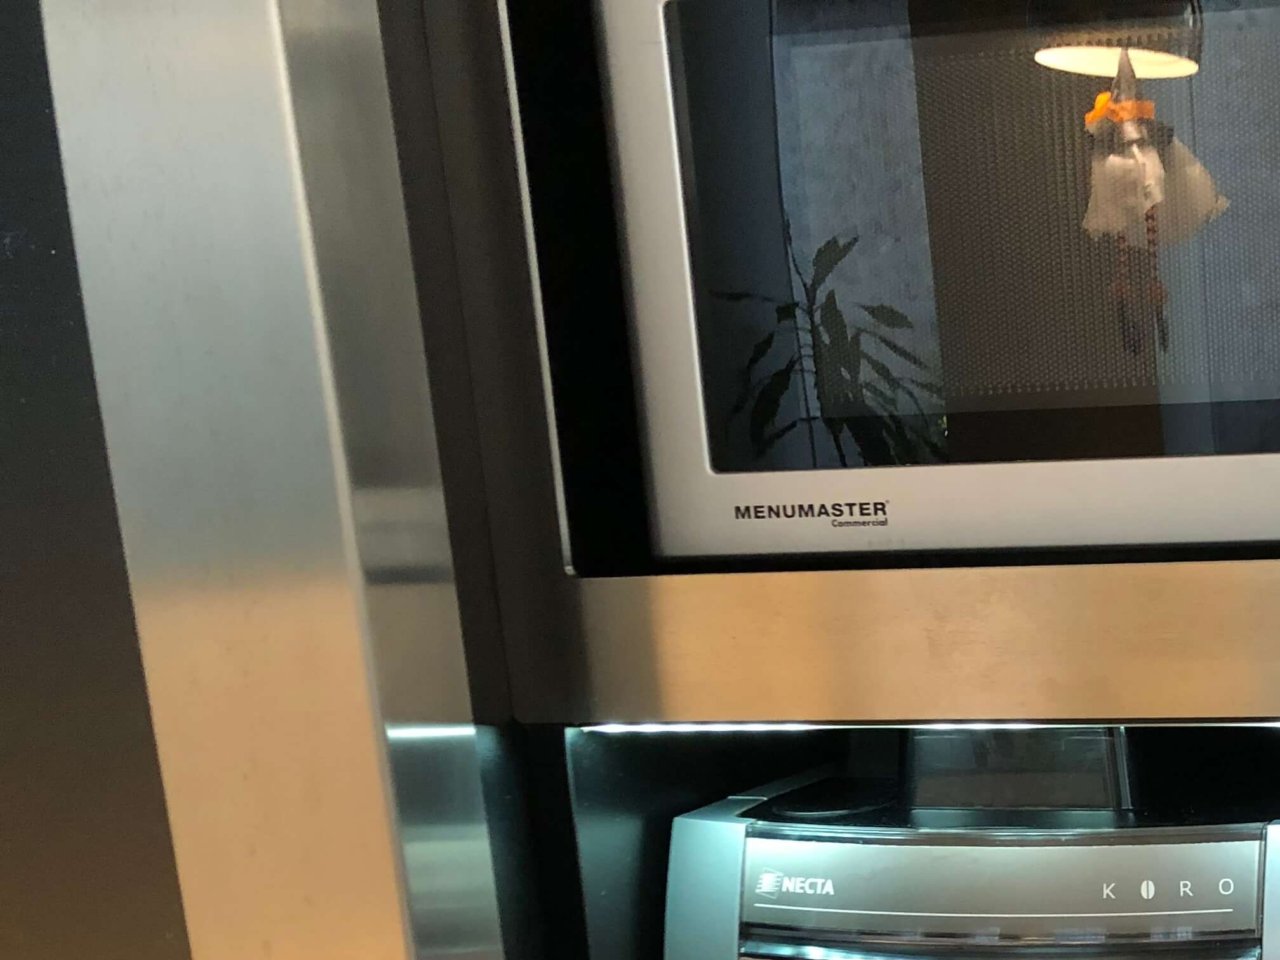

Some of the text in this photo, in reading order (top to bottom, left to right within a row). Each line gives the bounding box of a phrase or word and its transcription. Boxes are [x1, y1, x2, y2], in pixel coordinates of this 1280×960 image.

[735, 502, 888, 519] MENUMASTER
[831, 519, 888, 528] Commercial
[781, 876, 835, 895] NECTA
